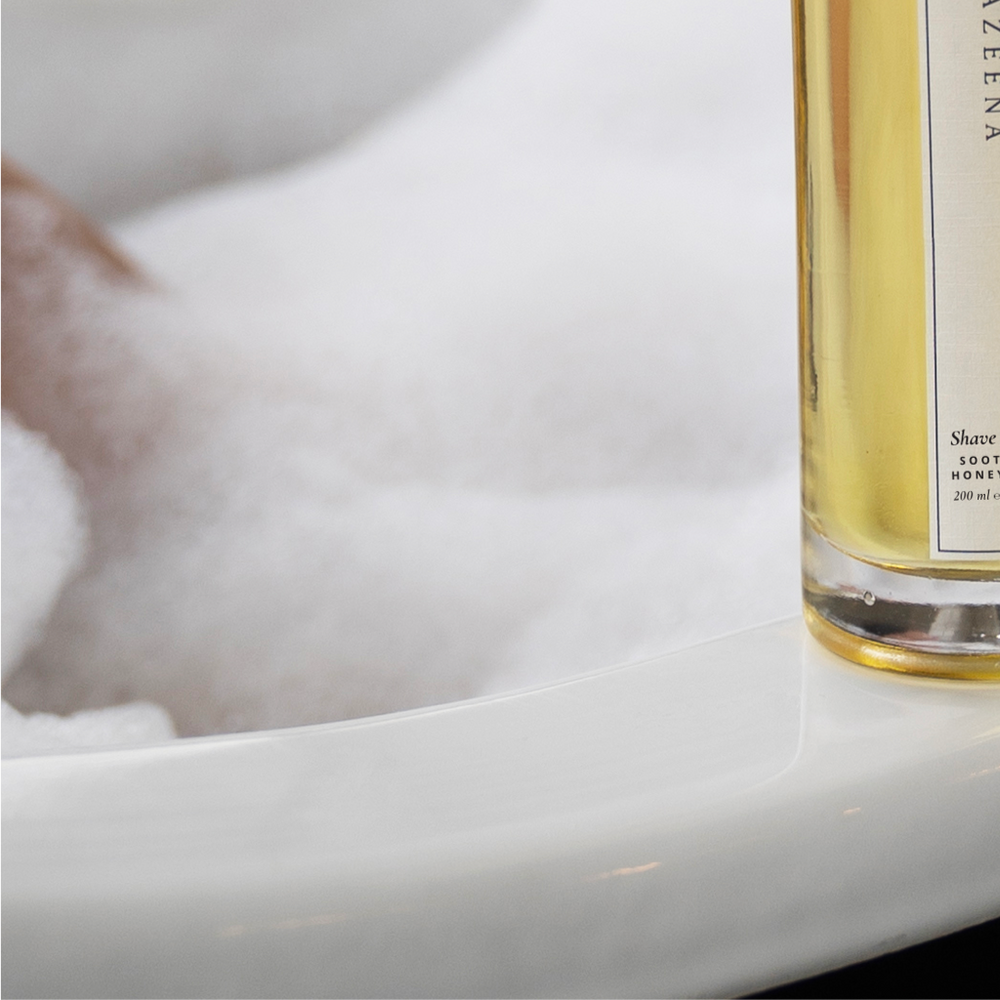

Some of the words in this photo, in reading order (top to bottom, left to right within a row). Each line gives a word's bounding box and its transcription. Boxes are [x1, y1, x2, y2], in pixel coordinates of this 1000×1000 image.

[950, 428, 997, 446] Shave
[953, 490, 974, 502] 200
[976, 488, 991, 501] ml
